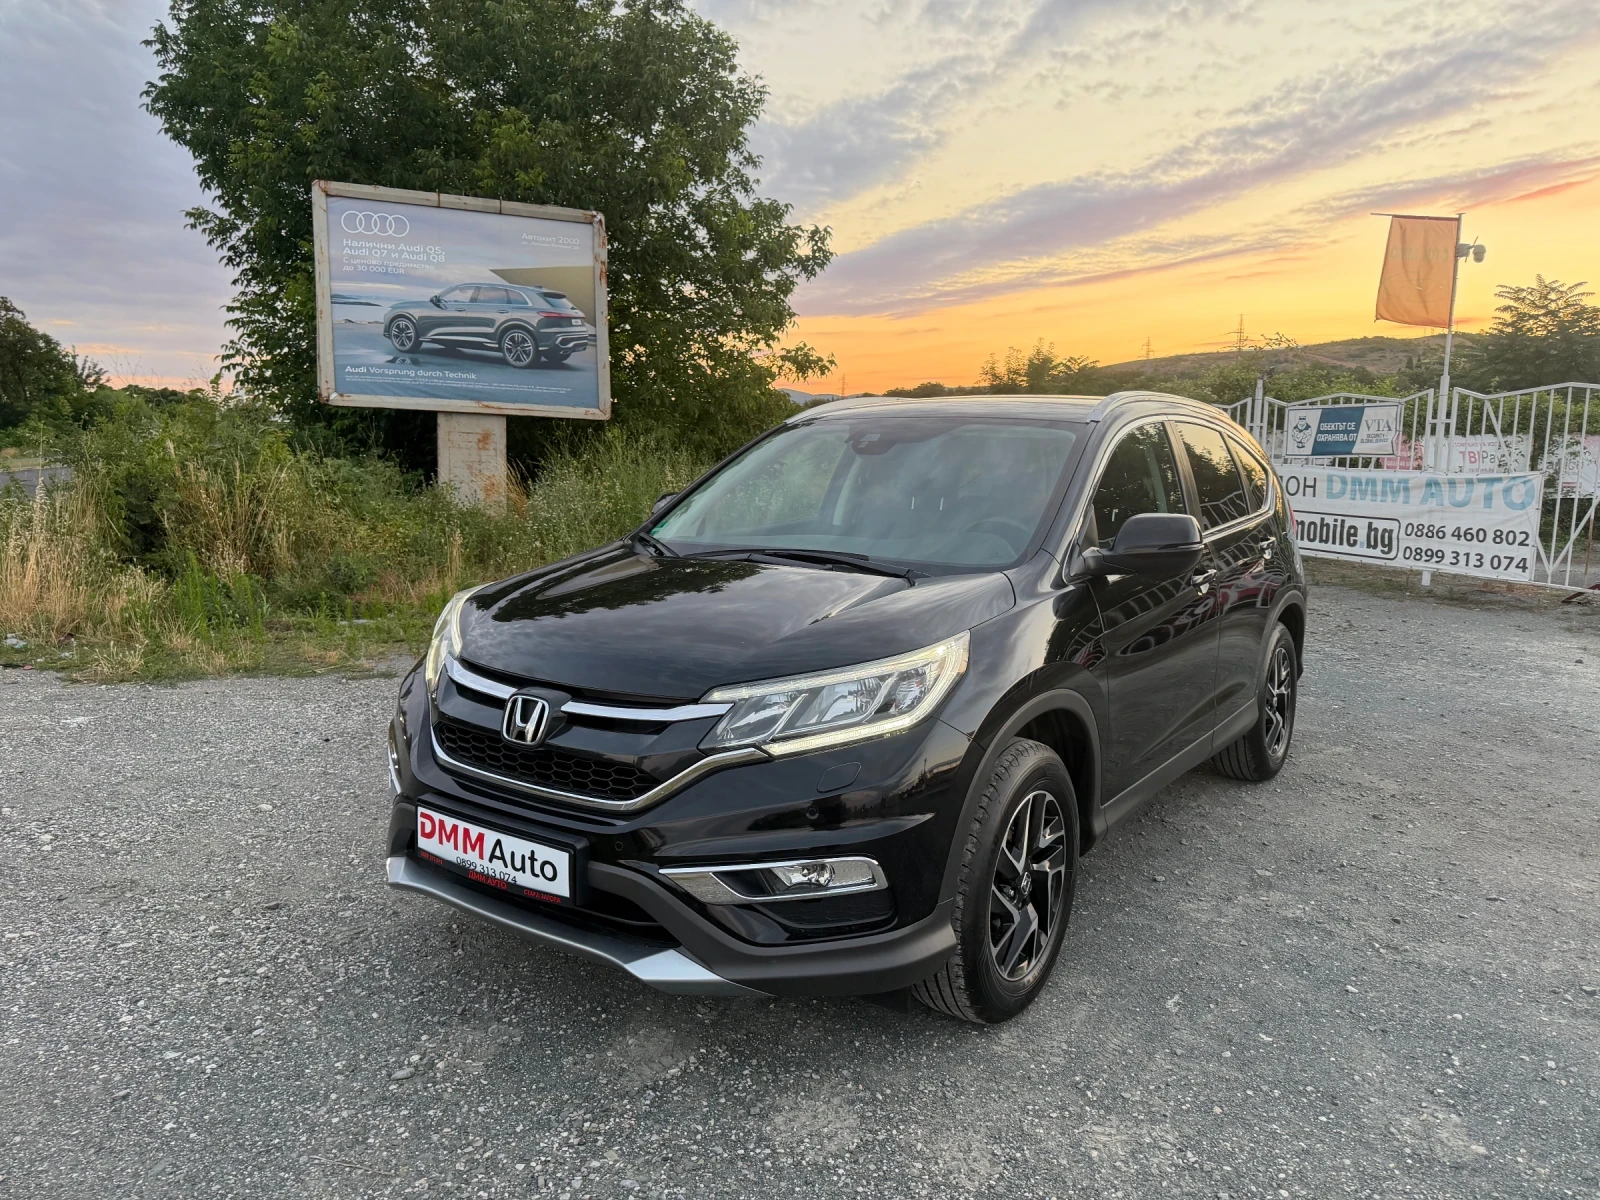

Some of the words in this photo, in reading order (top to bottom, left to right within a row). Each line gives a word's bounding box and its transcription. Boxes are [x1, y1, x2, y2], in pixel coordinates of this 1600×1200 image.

[343, 238, 395, 250] Налични
[398, 243, 424, 253] Audi
[521, 232, 557, 242] Автохит
[558, 236, 580, 245] 2000
[343, 247, 369, 256] Audi
[372, 249, 388, 258] Q7
[401, 252, 427, 261] Audi
[429, 254, 446, 263] Q8
[350, 258, 382, 266] ценово
[383, 260, 435, 270] предимство
[369, 265, 386, 273] 000
[388, 267, 405, 275] EUR
[345, 365, 367, 373] Audi
[368, 366, 416, 377] Vorsprung
[417, 369, 443, 378] durch
[443, 370, 477, 380] Technik
[1320, 422, 1347, 431] ОБЕКТЪТ
[1347, 422, 1356, 430] СЕ
[1364, 419, 1393, 432] VTA
[1316, 433, 1348, 442] ОХРАНЯВА
[1349, 433, 1358, 442] ОТ
[1279, 475, 1317, 498] ОН
[1326, 474, 1411, 505] DMM
[1419, 476, 1536, 511] AUTO
[1404, 522, 1447, 540] 0886
[1451, 526, 1487, 543] 460
[1492, 529, 1530, 547] 802
[1402, 546, 1445, 564] 0899
[1449, 550, 1484, 569] 313
[1490, 554, 1529, 573] 074
[455, 856, 477, 871] 0899
[479, 863, 497, 878] 313
[499, 870, 518, 884] 074
[468, 870, 487, 884] ДММ
[487, 876, 507, 890] АУТО
[523, 888, 540, 898] СТАРА
[540, 892, 562, 904] ЗАГОРА
